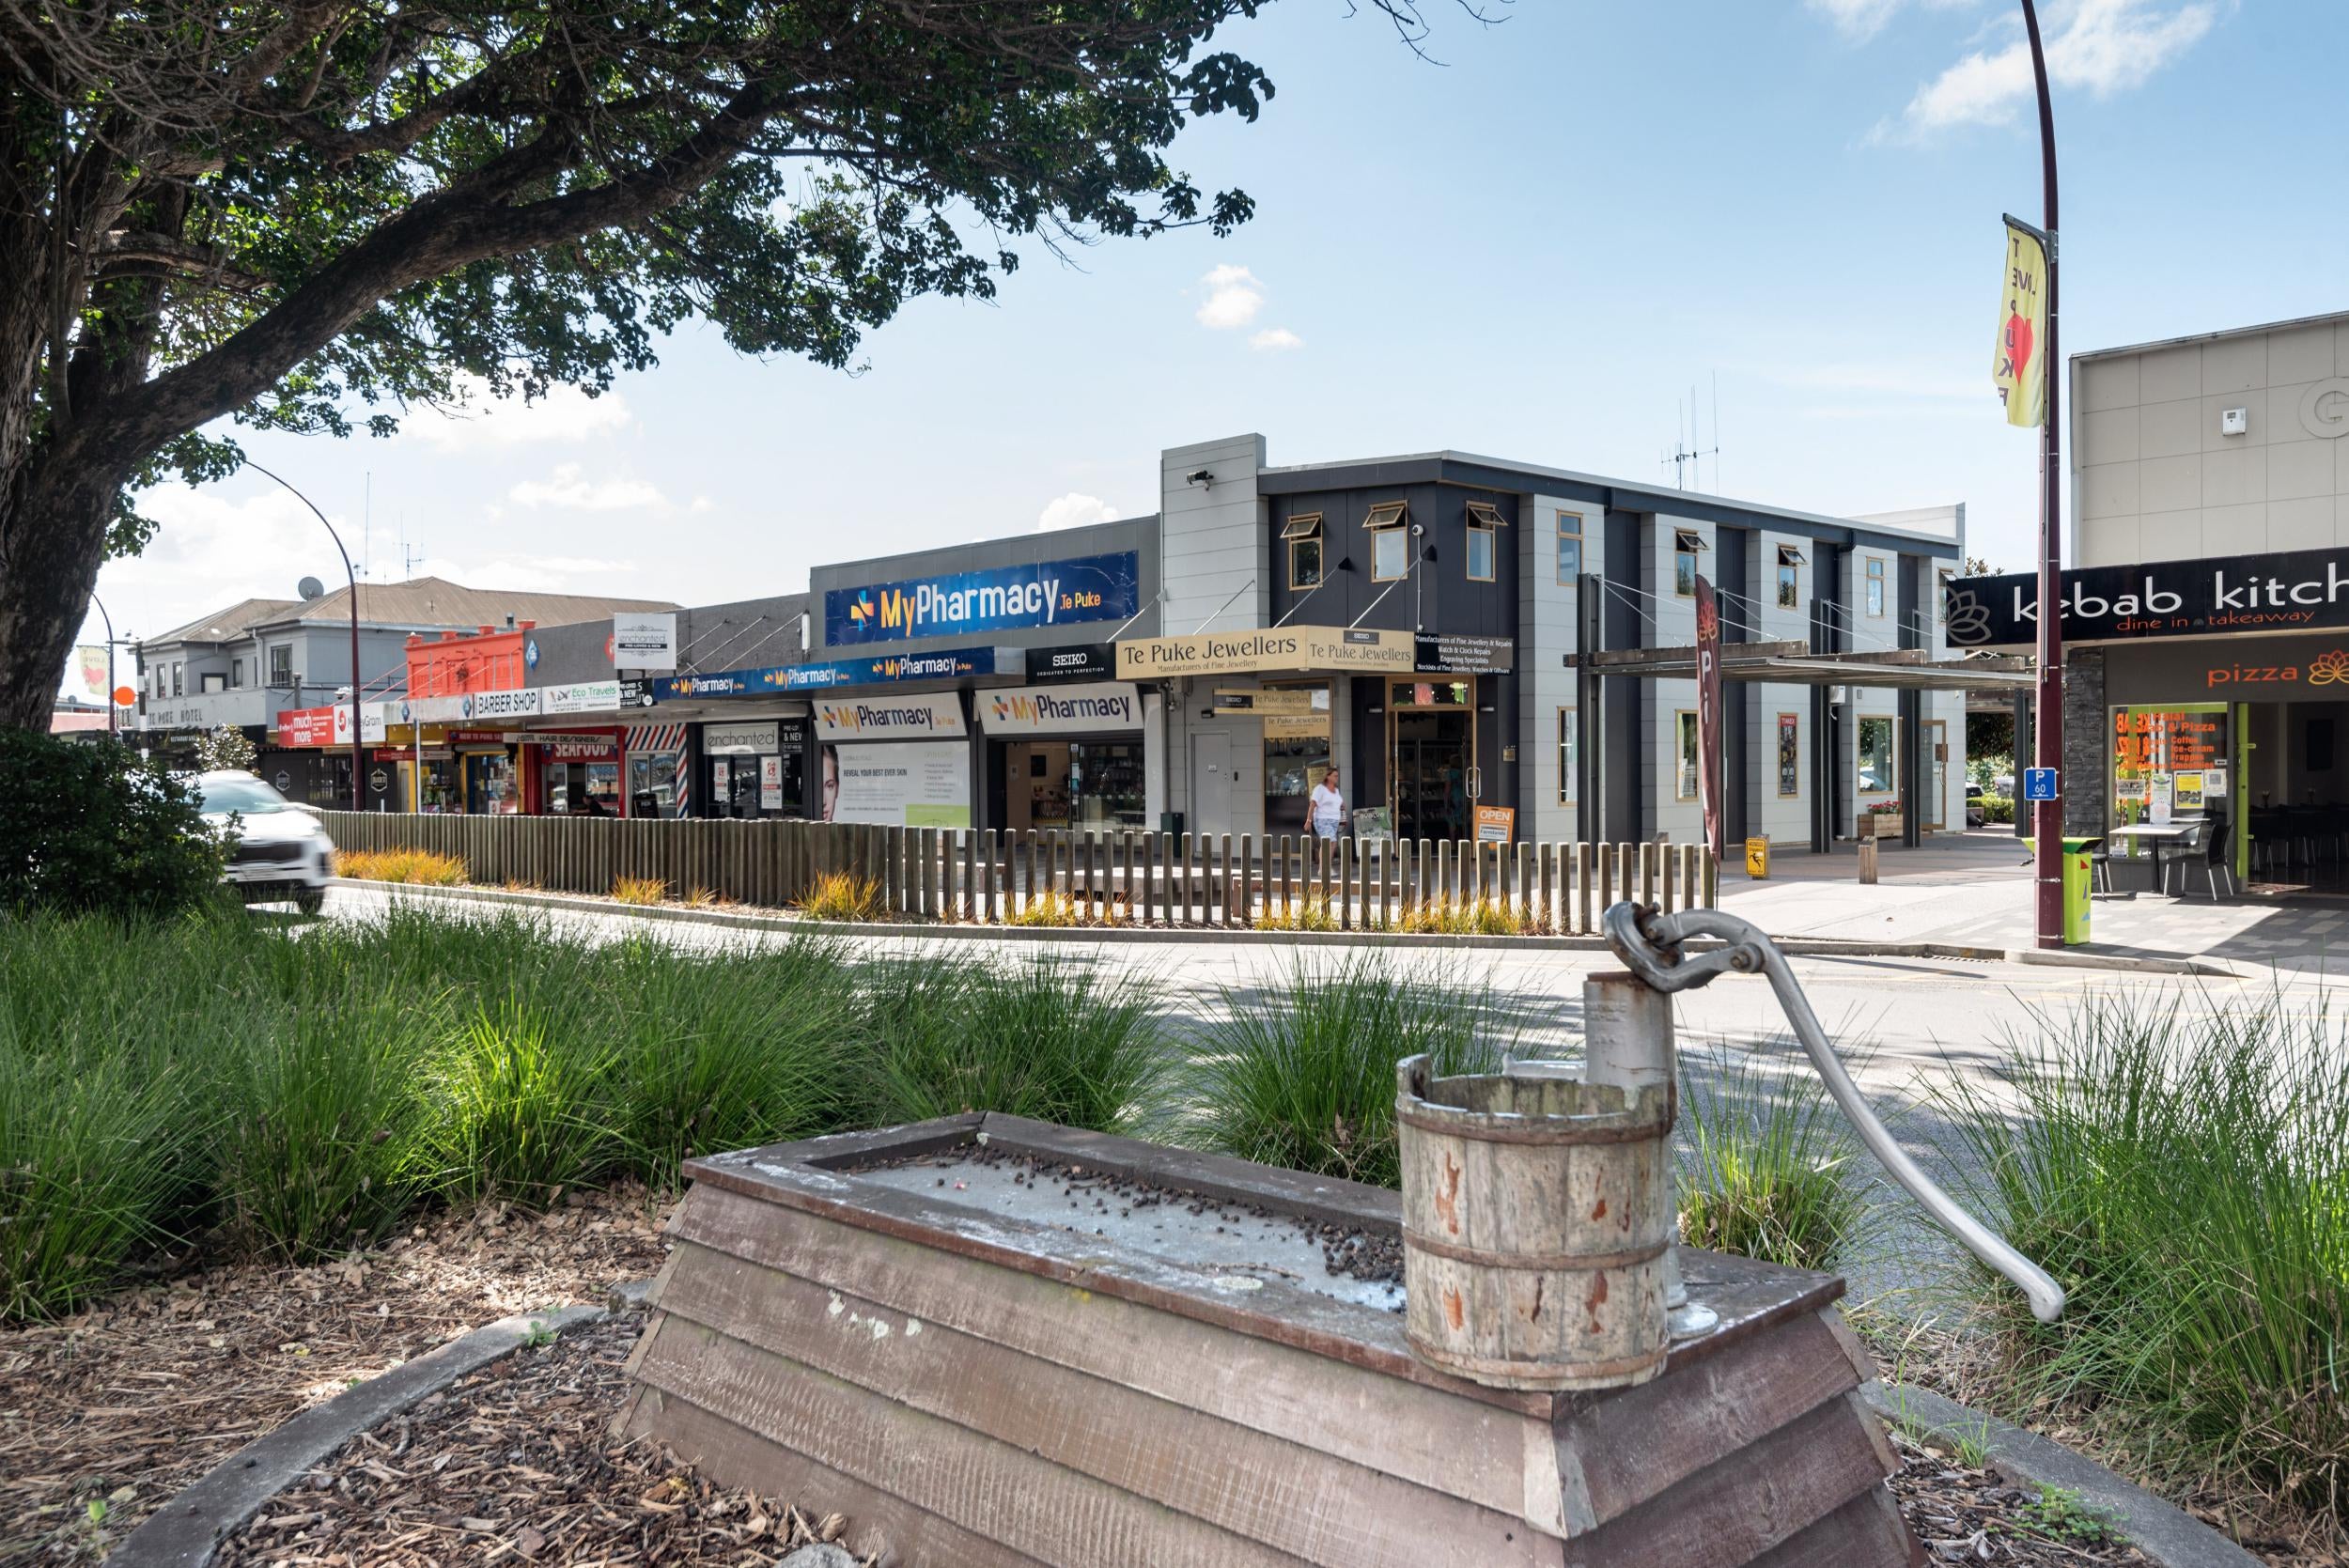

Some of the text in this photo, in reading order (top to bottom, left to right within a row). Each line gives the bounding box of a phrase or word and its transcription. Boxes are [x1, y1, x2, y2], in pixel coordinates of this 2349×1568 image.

[879, 579, 1060, 637] MyPharmacy
[1074, 591, 1101, 609] Puke
[2116, 610, 2315, 631] dine in takeaway
[1415, 635, 1449, 644] Manufacturers
[1466, 638, 1488, 647] Jewellery
[1495, 640, 1513, 648] Repairs
[1124, 636, 1297, 664] Te Puke Jewellers
[1310, 644, 1411, 661] Te Puke Jewellers
[1052, 652, 1088, 667] SEIKO
[1158, 662, 1202, 673] Manufacturers
[1203, 661, 1209, 670] of
[1226, 660, 1257, 669] Jewellery
[1439, 655, 1489, 664] Engraving Specialists
[884, 657, 957, 680] MyPharmacy
[2208, 663, 2298, 688] pizza
[680, 677, 734, 697] MyPharmacy
[775, 668, 836, 691] MyPharmacy
[571, 686, 616, 697] Eco Travels
[1254, 694, 1263, 703] Te
[1280, 695, 1310, 704] Jewellers
[478, 693, 511, 714] BARBER
[513, 691, 537, 712] SHOP
[1011, 694, 1129, 726] MyPharmacy
[180, 707, 203, 722] HOTEL
[293, 711, 312, 729] much
[837, 705, 933, 733] MyPharmacy
[347, 715, 381, 730] MyGram
[2181, 722, 2216, 732] Pizza
[294, 730, 312, 743] more
[559, 735, 601, 743] DESIGNERS
[707, 730, 775, 747] enchanted
[843, 768, 860, 777] REVEAL
[861, 768, 872, 777] YOUR
[896, 768, 908, 776] SKIN
[2035, 770, 2046, 783] P
[2034, 784, 2046, 793] 60
[1479, 810, 1511, 821] OPEN
